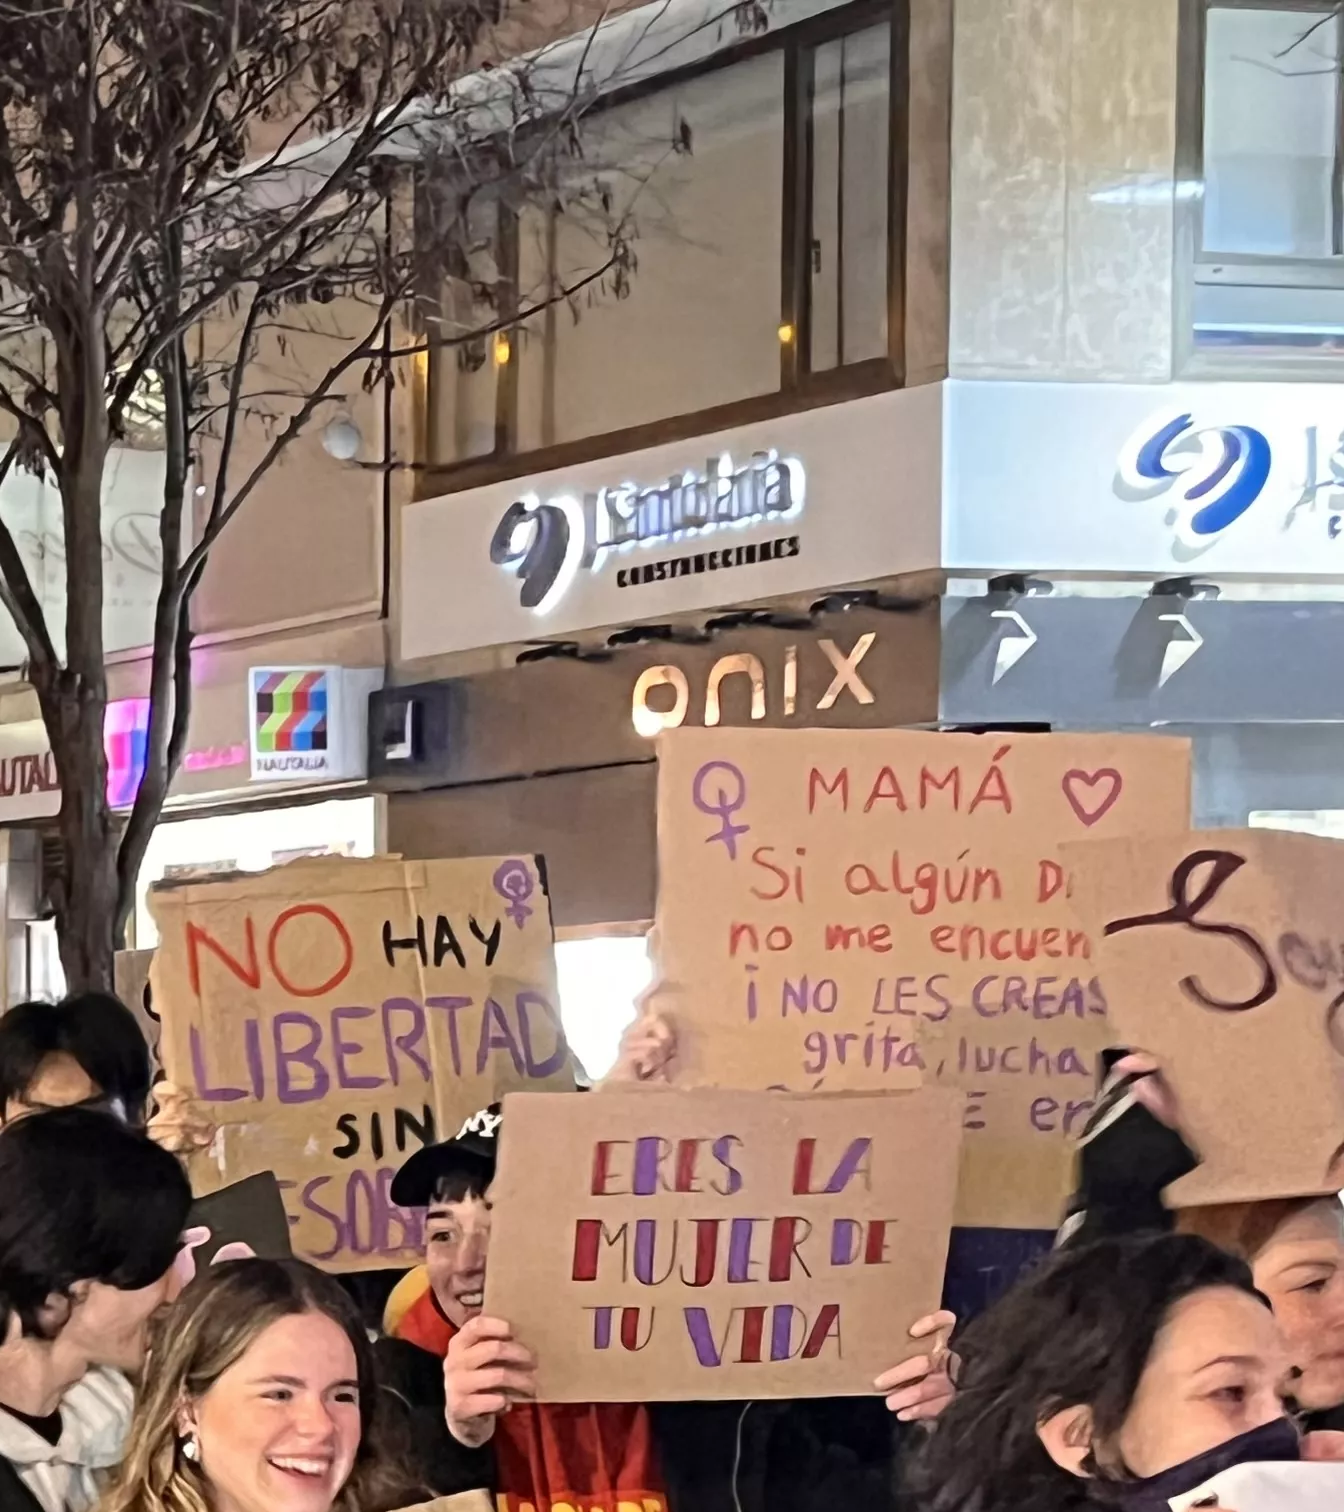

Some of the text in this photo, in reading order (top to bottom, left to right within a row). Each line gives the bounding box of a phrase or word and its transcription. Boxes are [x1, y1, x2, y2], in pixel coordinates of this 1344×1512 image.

[807, 746, 1012, 815] MAMÁ
[751, 846, 804, 901] Si
[845, 850, 1002, 916] algún
[187, 903, 501, 998] NO HAY
[728, 923, 792, 957] no
[825, 921, 893, 953] me
[873, 974, 950, 1022] LES
[189, 992, 568, 1105] LIBERTAD
[333, 1103, 437, 1160] SIN
[591, 1135, 872, 1197] ERES LA
[570, 1216, 898, 1288] MUJER DE
[581, 1303, 842, 1368] TU VIDA
